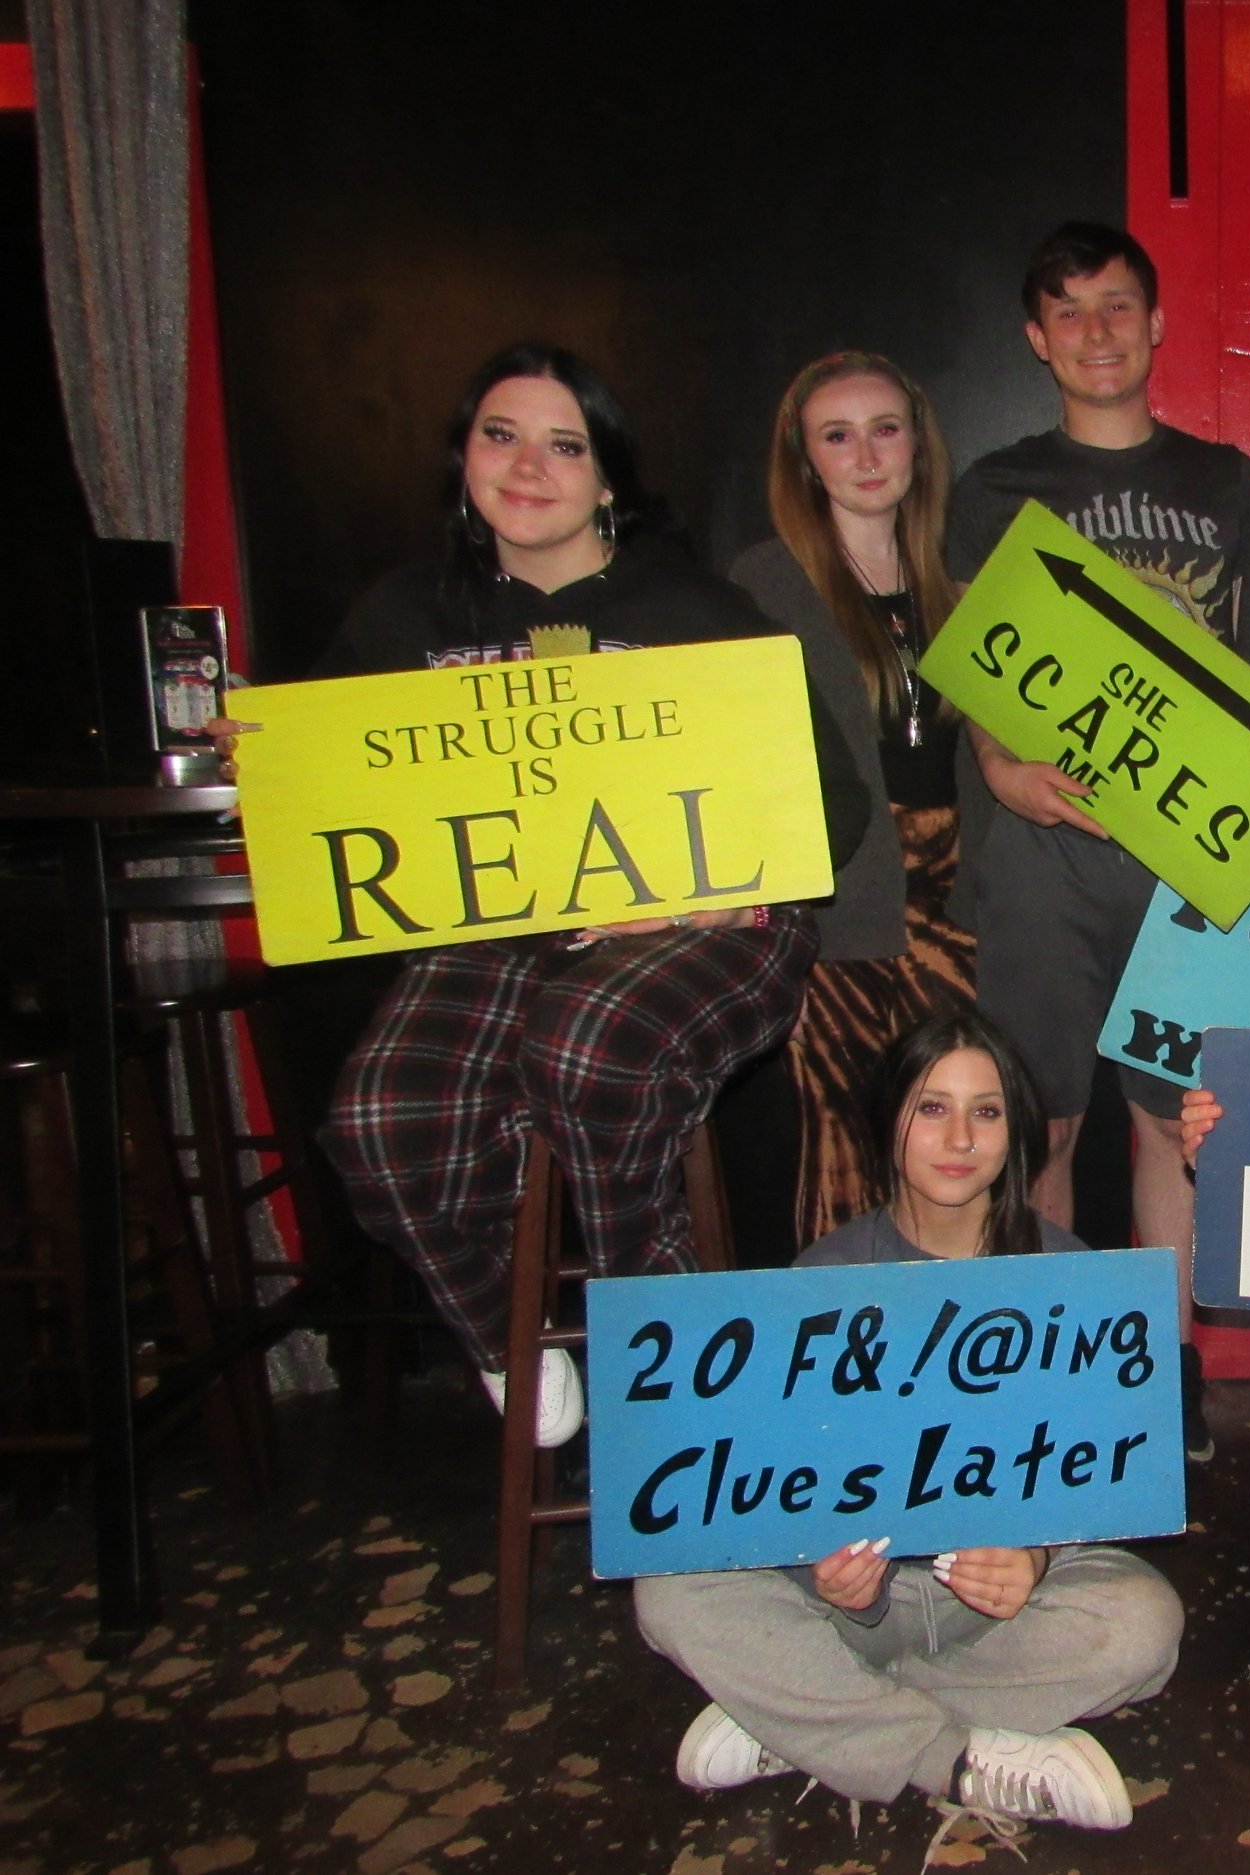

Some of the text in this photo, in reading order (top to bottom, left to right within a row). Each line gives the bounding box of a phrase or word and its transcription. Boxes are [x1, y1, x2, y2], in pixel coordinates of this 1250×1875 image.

[1066, 490, 1222, 550] ublime
[460, 664, 579, 712] THE
[1101, 662, 1179, 733] SHE
[363, 699, 683, 769] STRUGGLE
[970, 621, 1250, 864] SCARES
[507, 756, 558, 798] IS
[311, 787, 765, 945] REAL
[625, 1319, 756, 1402] 20
[628, 1420, 1148, 1535] Clues Later
